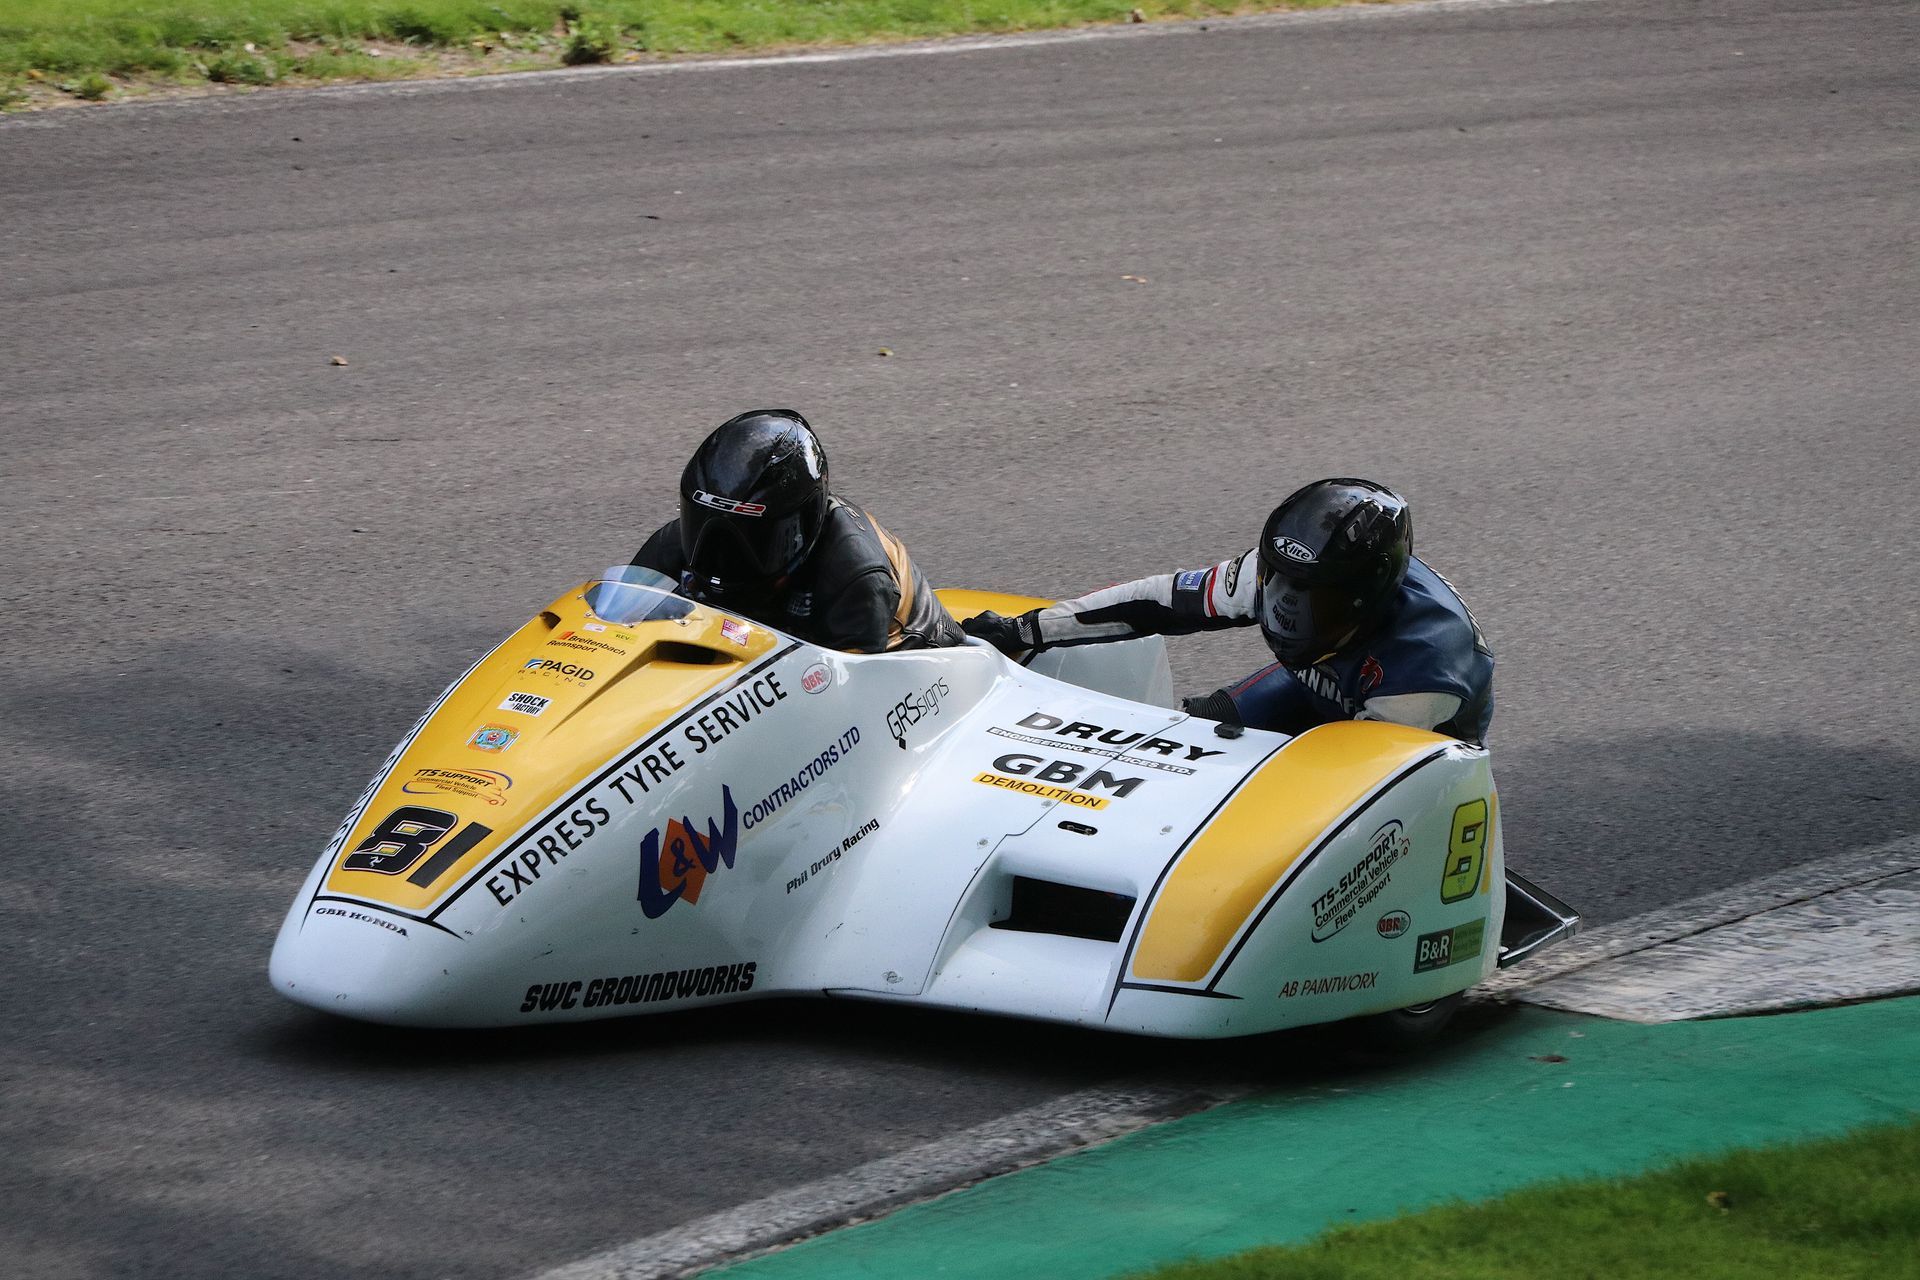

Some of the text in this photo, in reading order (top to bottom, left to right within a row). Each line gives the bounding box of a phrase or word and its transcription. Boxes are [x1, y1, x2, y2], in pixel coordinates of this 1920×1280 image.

[693, 490, 766, 517] LS2
[1277, 538, 1311, 561] X-lite
[547, 640, 598, 653] Rennsport
[568, 635, 626, 656] Breitenbach
[517, 670, 587, 688] RACING
[540, 660, 594, 681] PAGID
[508, 692, 549, 707] SHOCK
[512, 703, 541, 715] FACTORY
[1016, 712, 1227, 761] DRURY
[989, 727, 1193, 776] ENGINEERING SERVICES LTD.
[414, 768, 494, 787] TTS SUPPORT
[416, 777, 477, 791] Commercial Vehicle
[485, 671, 787, 906] EXPRESS TYRE SERVICE
[742, 726, 861, 830] CONTRACTORS LTD
[993, 753, 1147, 798] GBM
[435, 783, 479, 798] Fleet Support
[979, 774, 1103, 808] DEMOLITION
[637, 784, 738, 919] L&W
[785, 818, 881, 895] Phil Drury Racing
[1311, 829, 1398, 917] TTS-SUPPORT
[1314, 848, 1399, 928] Commercial Vehicle
[1334, 872, 1392, 930] Fleet Support
[315, 907, 409, 938] GBR HONDA
[1419, 935, 1451, 962] B&R
[520, 961, 757, 1012] SWC GROUNDWORKS
[1278, 971, 1379, 998] AB PAINTWORX
